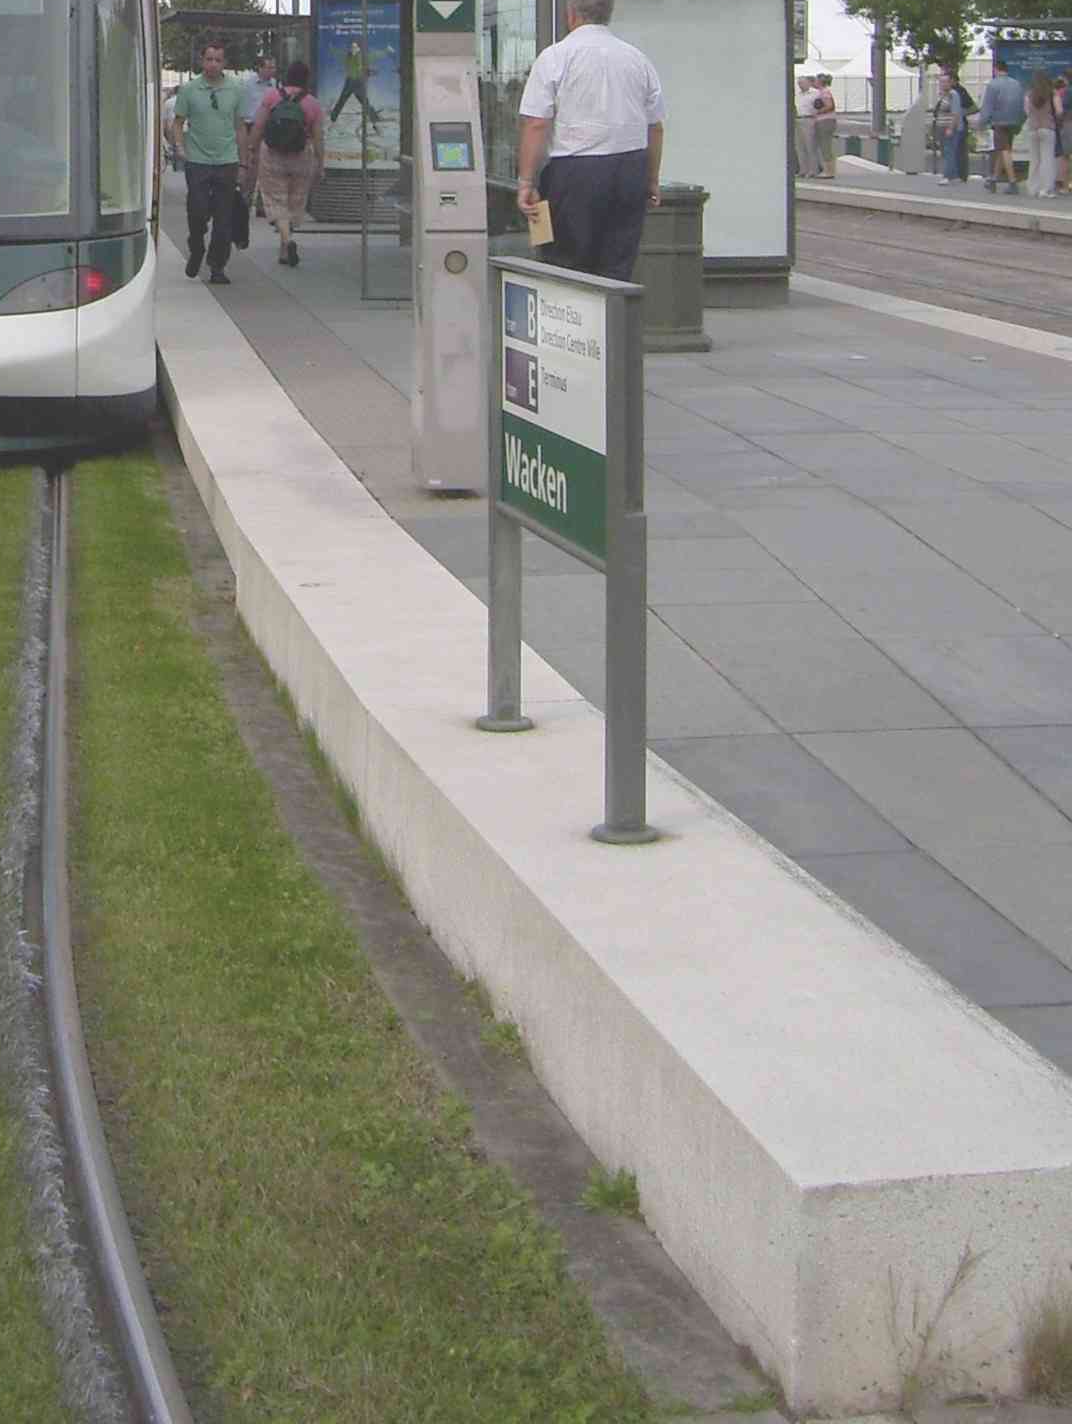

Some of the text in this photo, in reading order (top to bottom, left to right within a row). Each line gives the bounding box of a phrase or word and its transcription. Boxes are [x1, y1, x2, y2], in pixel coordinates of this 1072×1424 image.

[527, 290, 536, 338] B
[528, 362, 537, 407] E
[505, 432, 567, 514] Wacken
